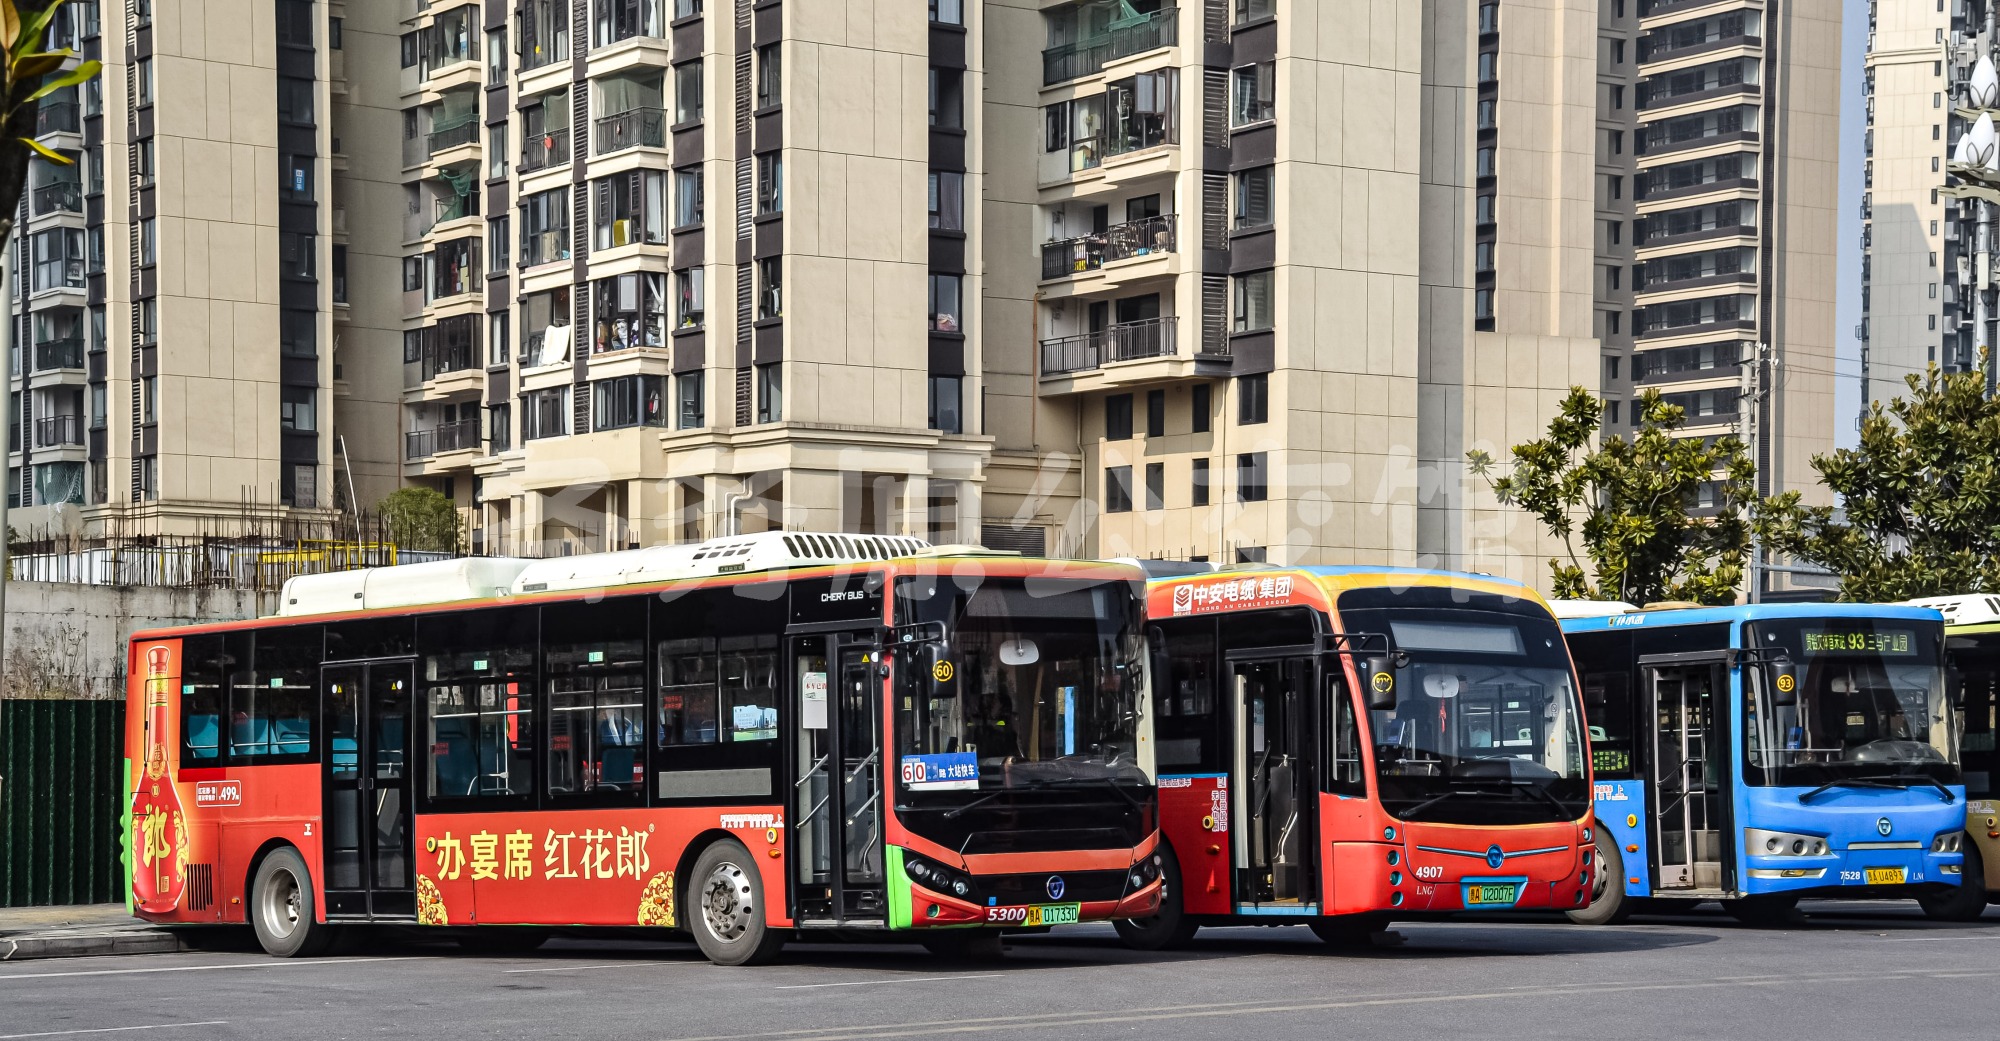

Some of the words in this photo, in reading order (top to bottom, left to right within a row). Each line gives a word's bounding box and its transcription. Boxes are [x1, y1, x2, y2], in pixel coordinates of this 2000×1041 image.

[821, 591, 848, 602] CHERY
[848, 590, 864, 600] BUS
[1848, 633, 1865, 650] 93
[936, 665, 950, 677] 60
[1780, 678, 1791, 688] 93
[903, 764, 925, 781] 60
[437, 829, 533, 880] 办宴席
[544, 826, 650, 880] 红花郎
[1416, 866, 1443, 878] 4907
[1840, 871, 1860, 880] 7528
[1416, 886, 1433, 895] LNG
[987, 907, 1026, 921] 5300
